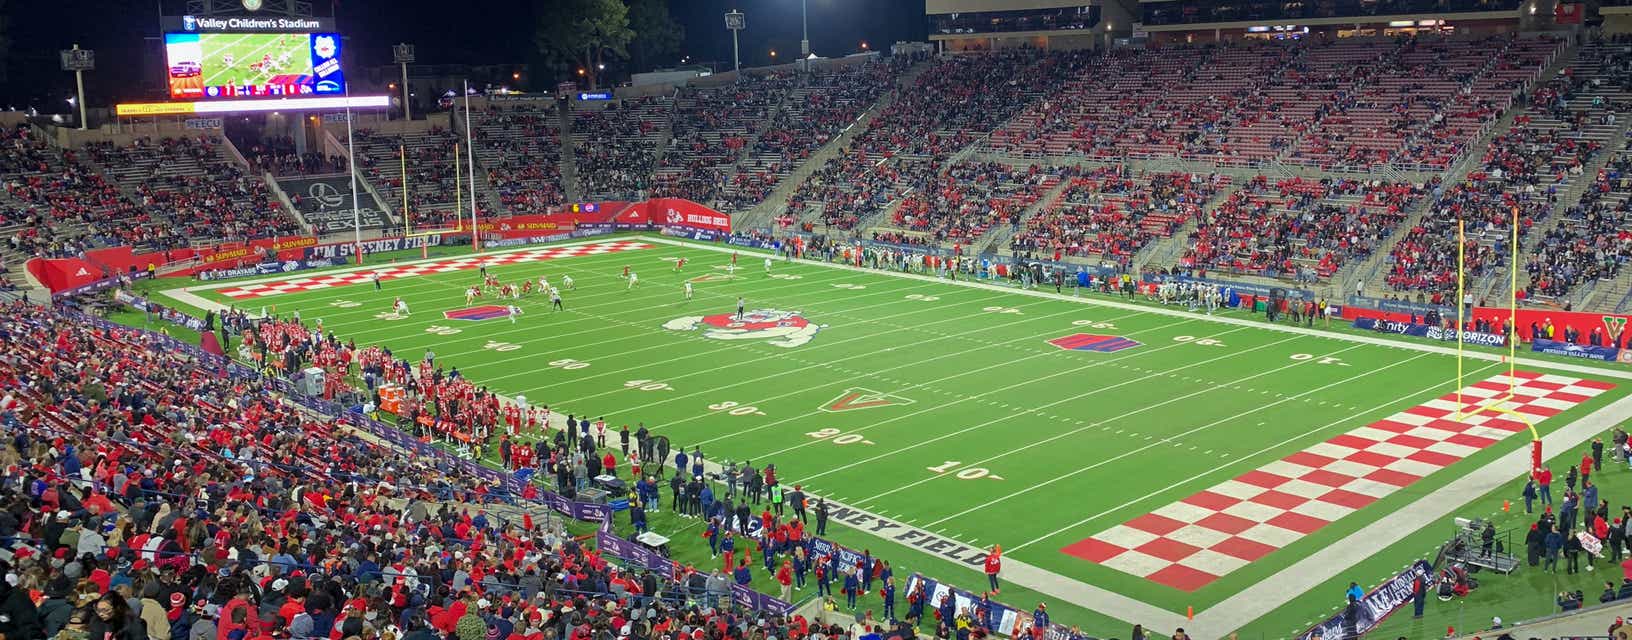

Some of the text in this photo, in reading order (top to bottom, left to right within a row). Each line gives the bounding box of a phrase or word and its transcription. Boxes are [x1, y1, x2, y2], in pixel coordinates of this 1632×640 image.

[196, 18, 320, 30] Valley Children's Stadium
[195, 120, 220, 128] EECU
[320, 217, 385, 230] EXUS
[311, 234, 441, 258] JIM SWEENEY FIELD
[1373, 320, 1409, 334] xnity
[708, 401, 758, 416] 30
[805, 427, 864, 445] 20
[927, 460, 990, 480] 10
[893, 529, 989, 566] FIELD
